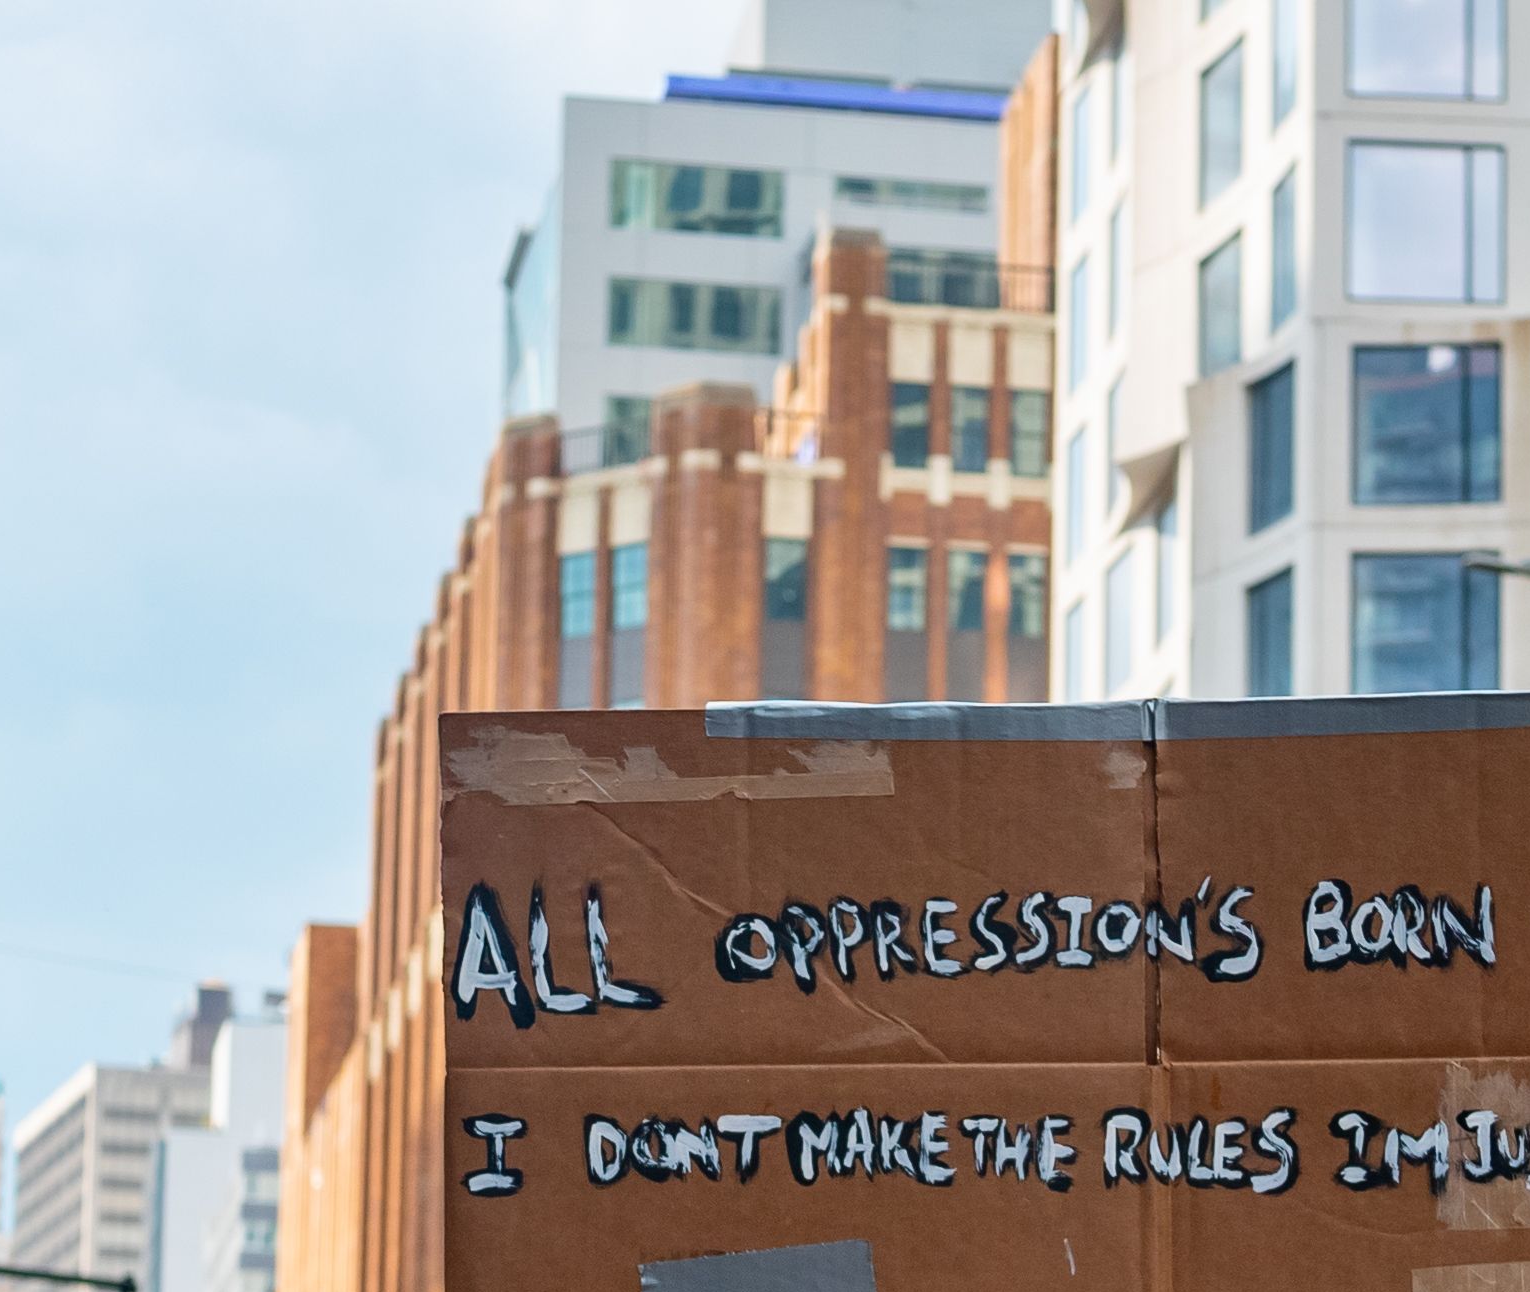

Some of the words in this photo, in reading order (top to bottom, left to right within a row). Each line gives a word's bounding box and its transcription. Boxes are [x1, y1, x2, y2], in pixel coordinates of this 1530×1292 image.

[453, 880, 666, 1028] ALL
[716, 875, 1262, 992] OPPRESSION'S
[1303, 877, 1495, 975] BORN
[463, 1113, 526, 1196] I
[785, 1106, 959, 1187] MAKE
[960, 1114, 1075, 1193] THE
[1104, 1107, 1296, 1194] RULES
